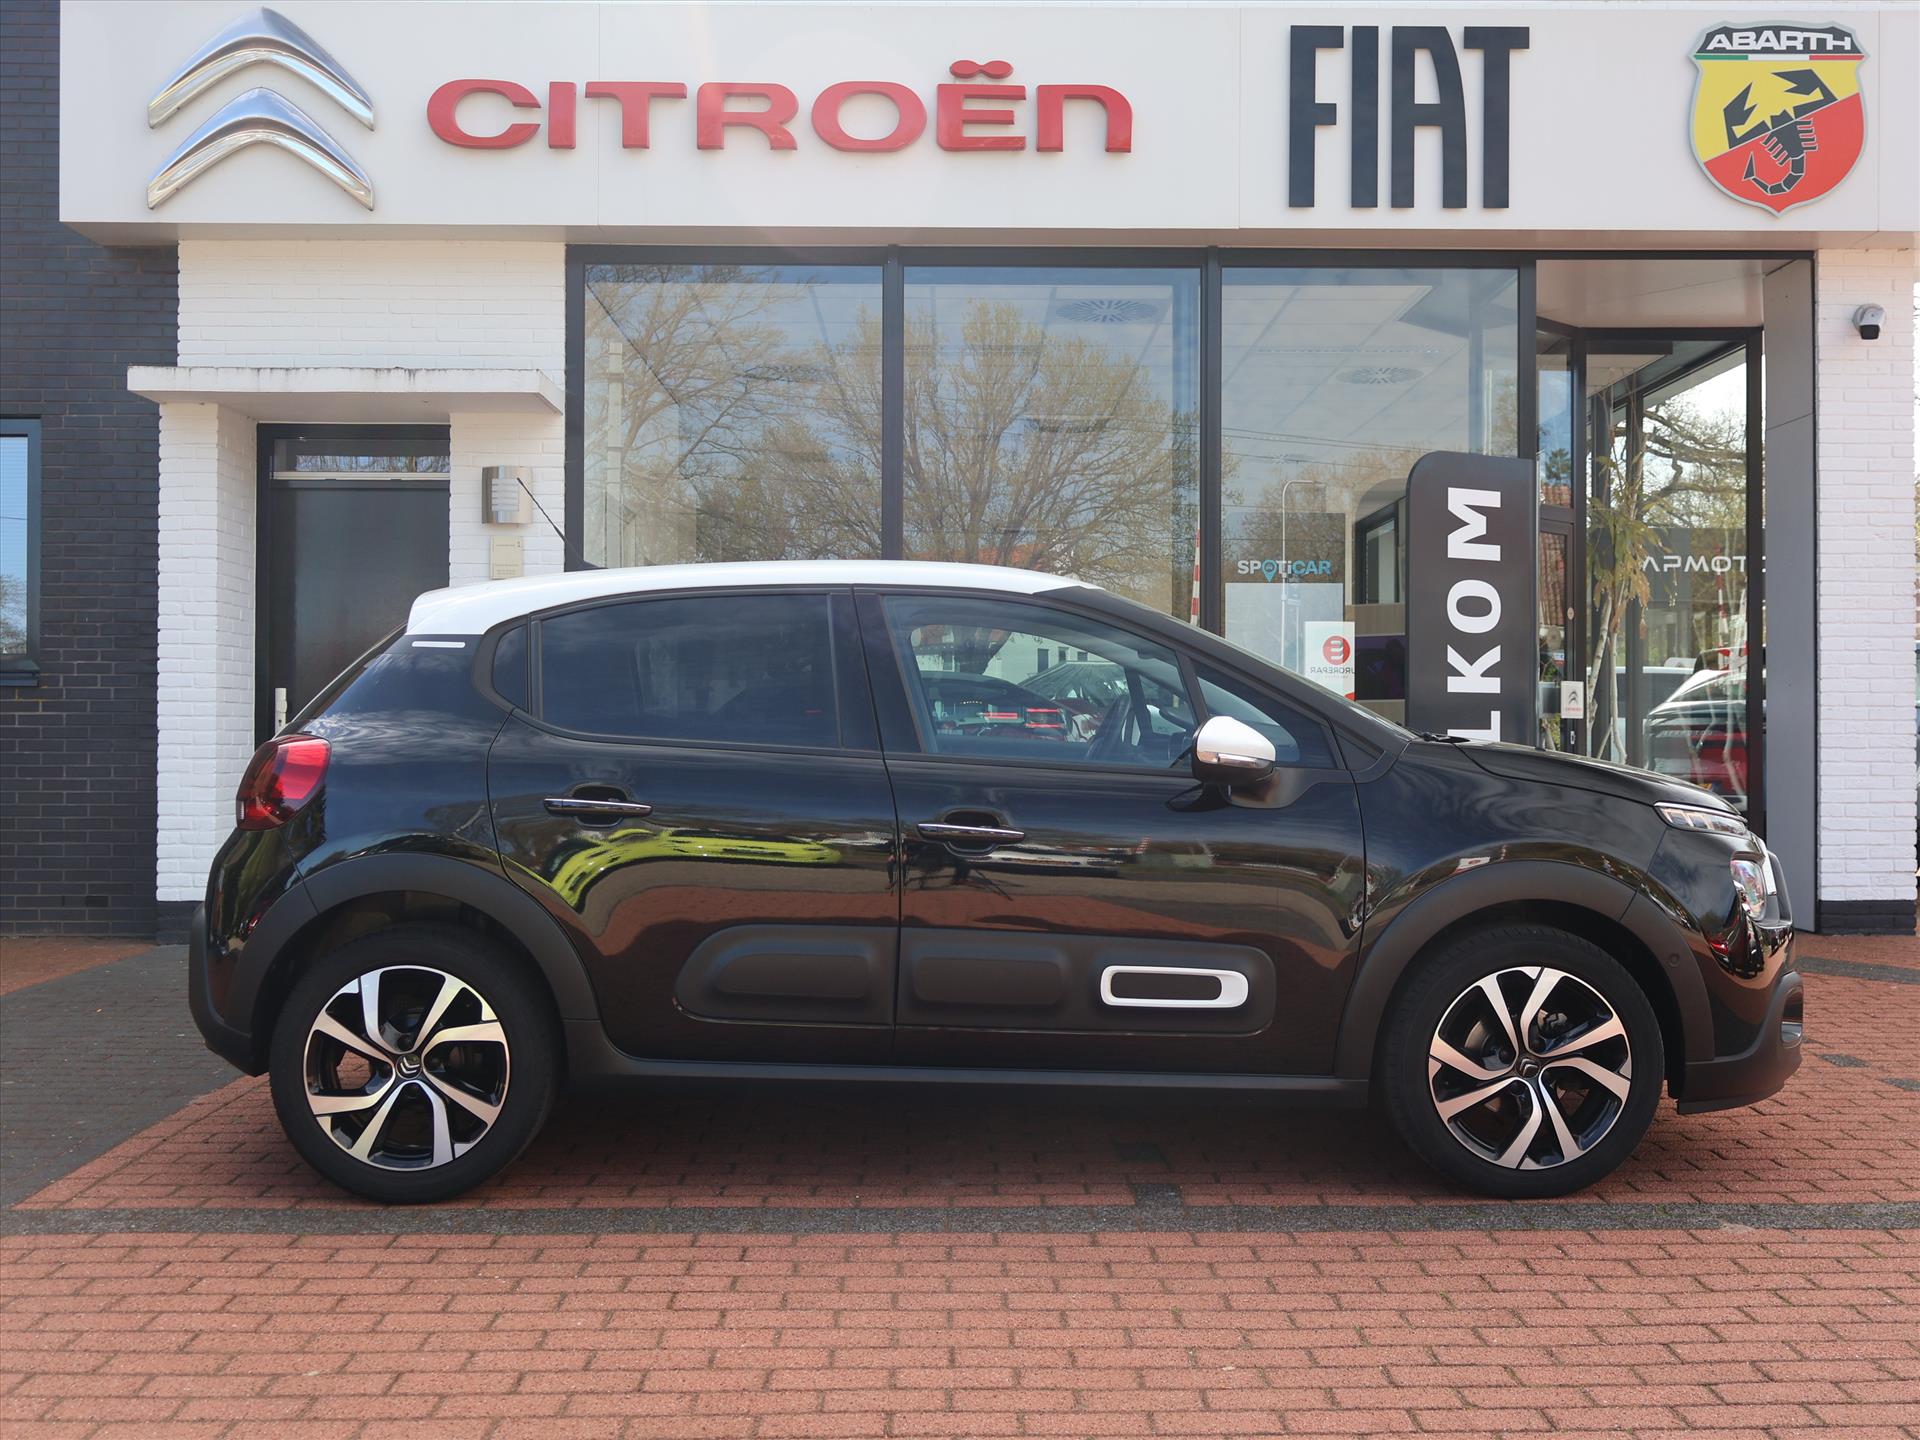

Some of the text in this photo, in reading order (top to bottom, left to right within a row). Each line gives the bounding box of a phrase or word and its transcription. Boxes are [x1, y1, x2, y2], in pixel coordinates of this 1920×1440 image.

[1288, 25, 1530, 209] FIAT
[1706, 30, 1851, 50] ABARTH
[1447, 487, 1501, 742] LKOM
